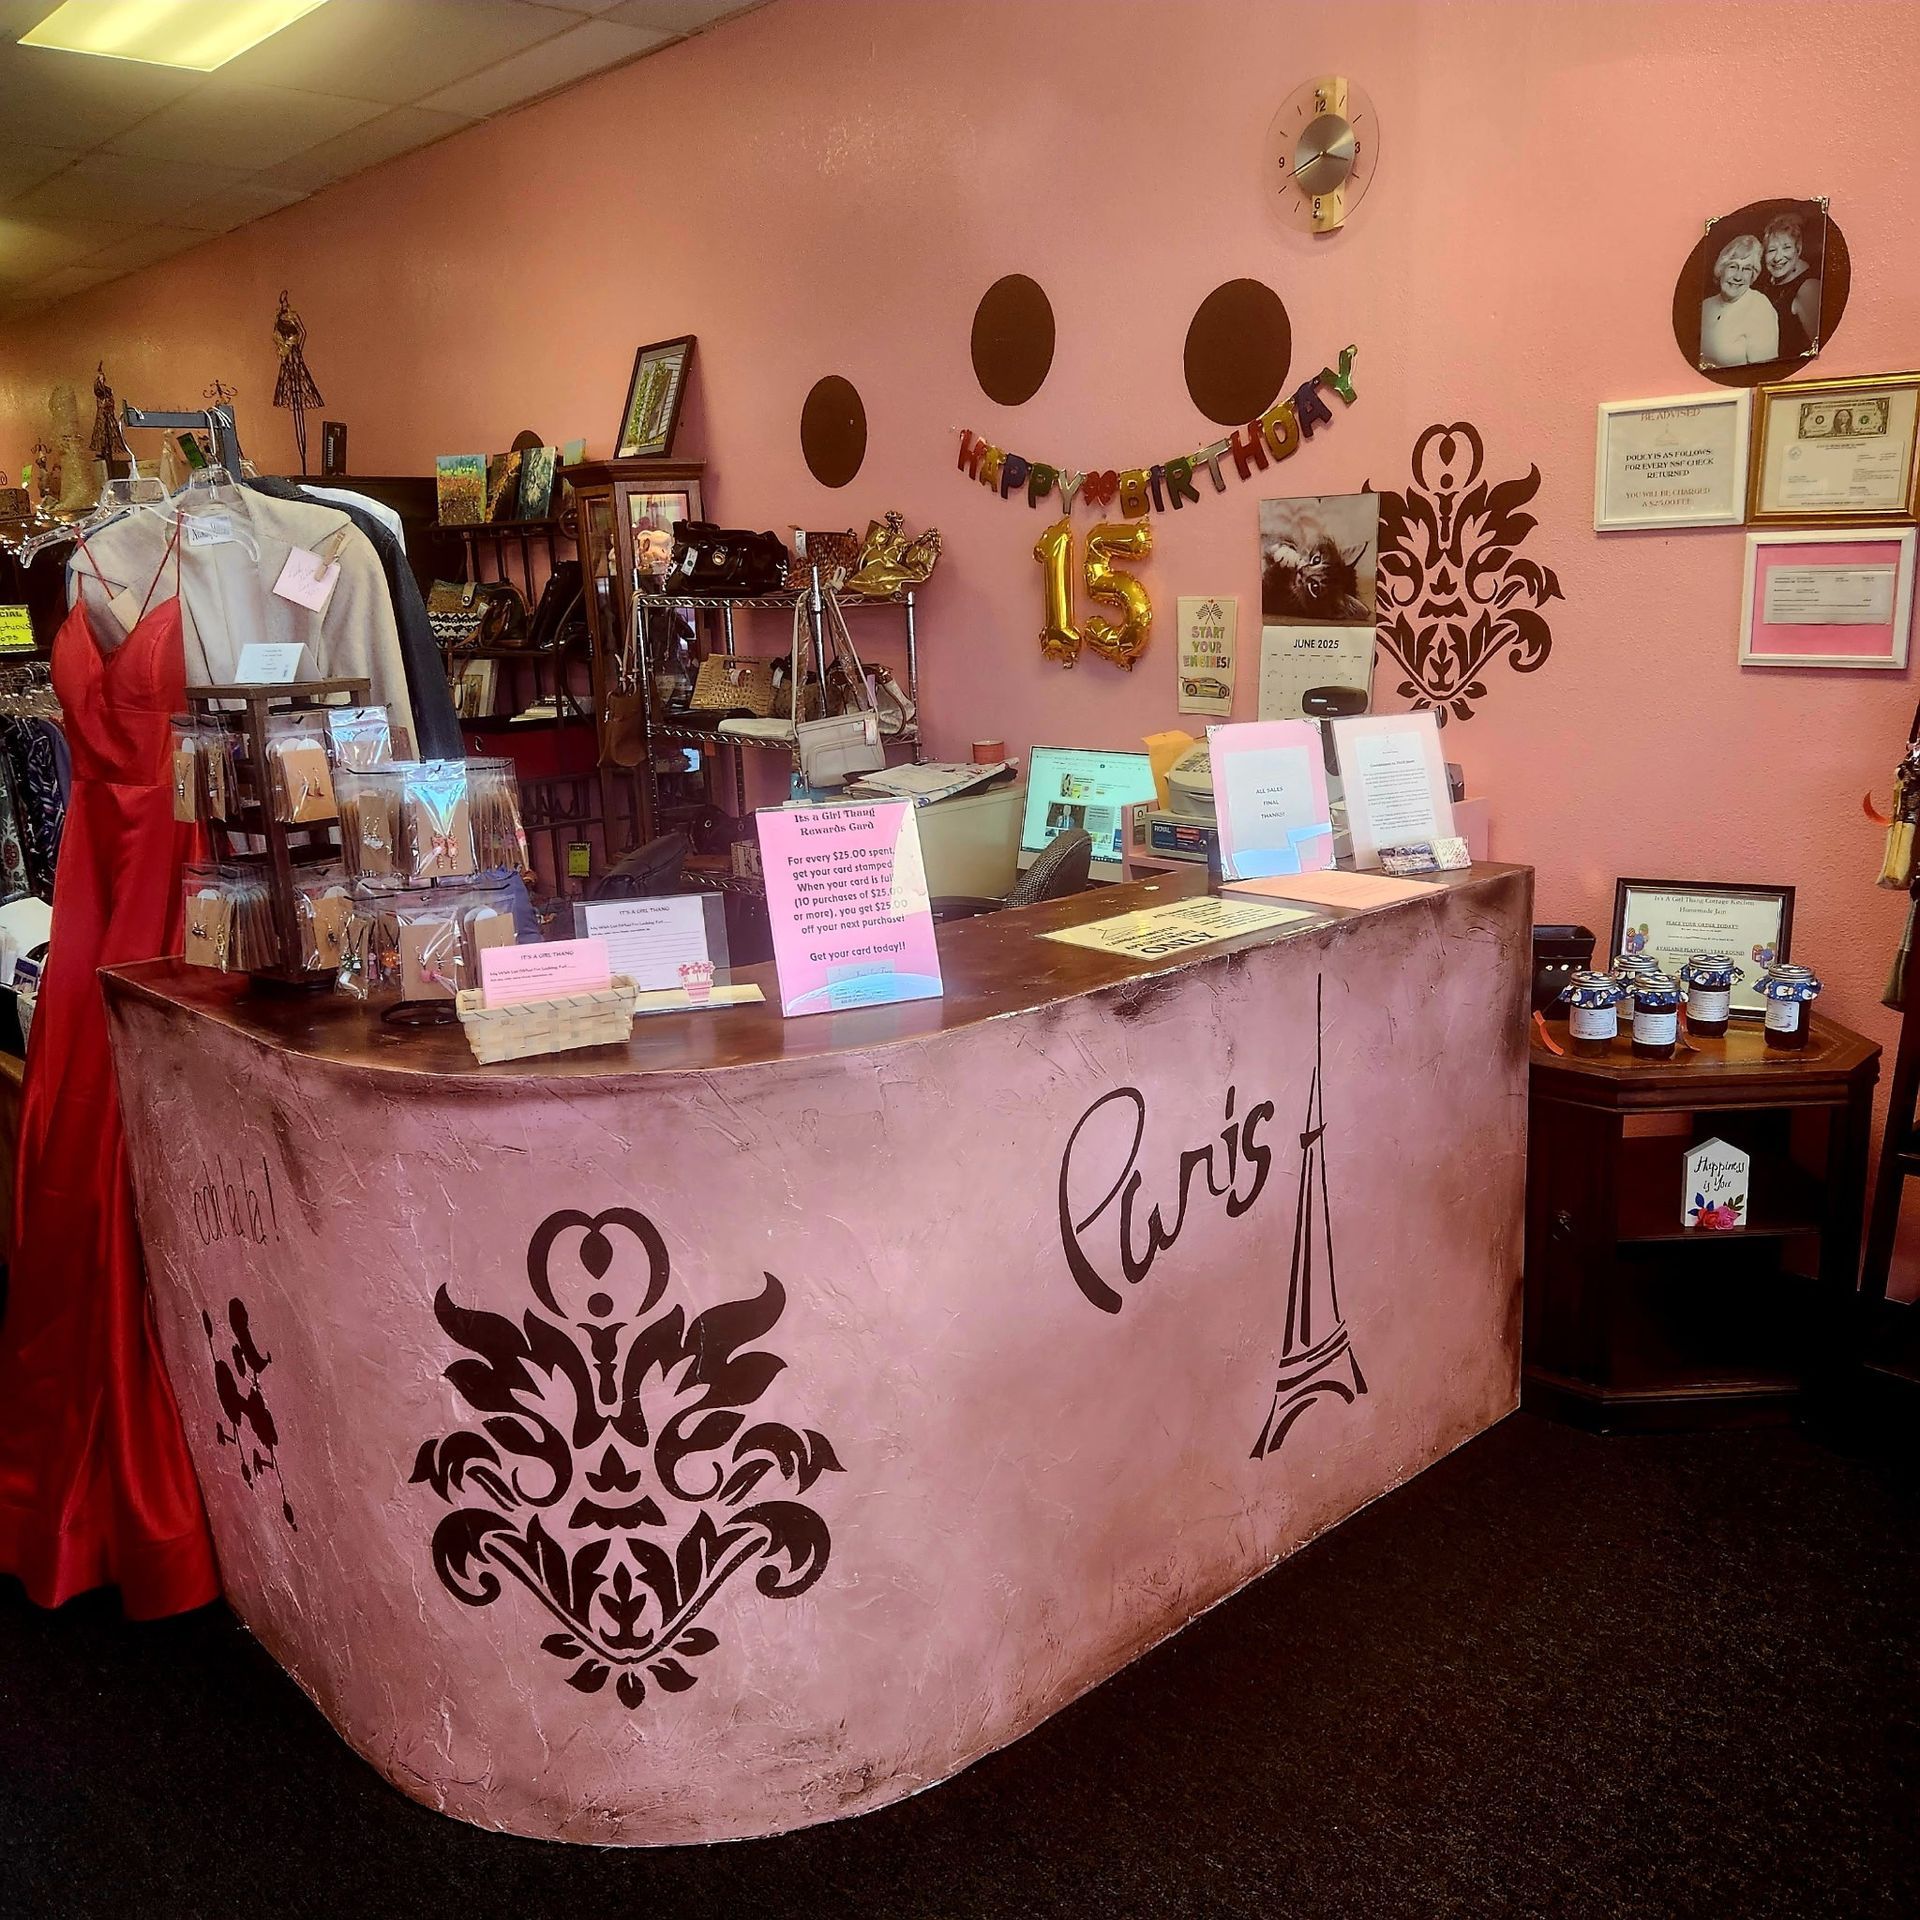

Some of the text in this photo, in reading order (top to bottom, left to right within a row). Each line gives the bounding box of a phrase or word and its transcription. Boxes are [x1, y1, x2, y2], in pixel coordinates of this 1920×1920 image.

[1314, 100, 1326, 112] 12
[1354, 142, 1361, 154] 3
[1278, 156, 1286, 168] 9
[1314, 198, 1321, 210] 6
[1640, 408, 1703, 422] BE ADVISED
[957, 344, 1358, 518] HAPPY BIRTHDAY
[1626, 452, 1654, 462] POLICY
[1654, 452, 1661, 460] IS
[1663, 451, 1674, 460] AS
[1625, 463, 1640, 471] FOR
[1642, 461, 1668, 470] EVERY
[1687, 458, 1714, 466] CHECK
[1647, 469, 1690, 478] RETURNED
[1626, 491, 1641, 499] YOU
[1642, 490, 1658, 498] WILL
[1672, 487, 1710, 496] CHARGED
[1033, 516, 1154, 671] 15
[1192, 626, 1225, 639] START
[1192, 641, 1222, 654] YOUR
[1294, 640, 1339, 648] JUNE 2025
[822, 810, 841, 820] Girl
[800, 824, 846, 836] Rewards
[788, 856, 803, 866] For
[806, 854, 831, 863] every
[833, 848, 866, 861] $25.00
[792, 871, 808, 880] get
[810, 868, 831, 878] your
[833, 864, 853, 874] card
[796, 882, 825, 892] When
[826, 879, 848, 891] your
[850, 876, 870, 886] card
[872, 874, 878, 884] is
[794, 896, 810, 908] (10
[812, 892, 858, 906] purchases
[860, 890, 869, 900] of
[793, 913, 804, 921] or
[840, 907, 856, 918] you
[858, 904, 874, 915] get
[802, 924, 815, 934] off
[817, 922, 838, 934] your
[840, 920, 860, 930] next
[1141, 932, 1218, 954] ONLY
[810, 952, 827, 962] Get
[829, 950, 850, 960] your
[852, 946, 871, 956] card
[1694, 1156, 1745, 1178] Happiness
[1703, 1174, 1732, 1192] is You
[1058, 1085, 1275, 1315] Paris
